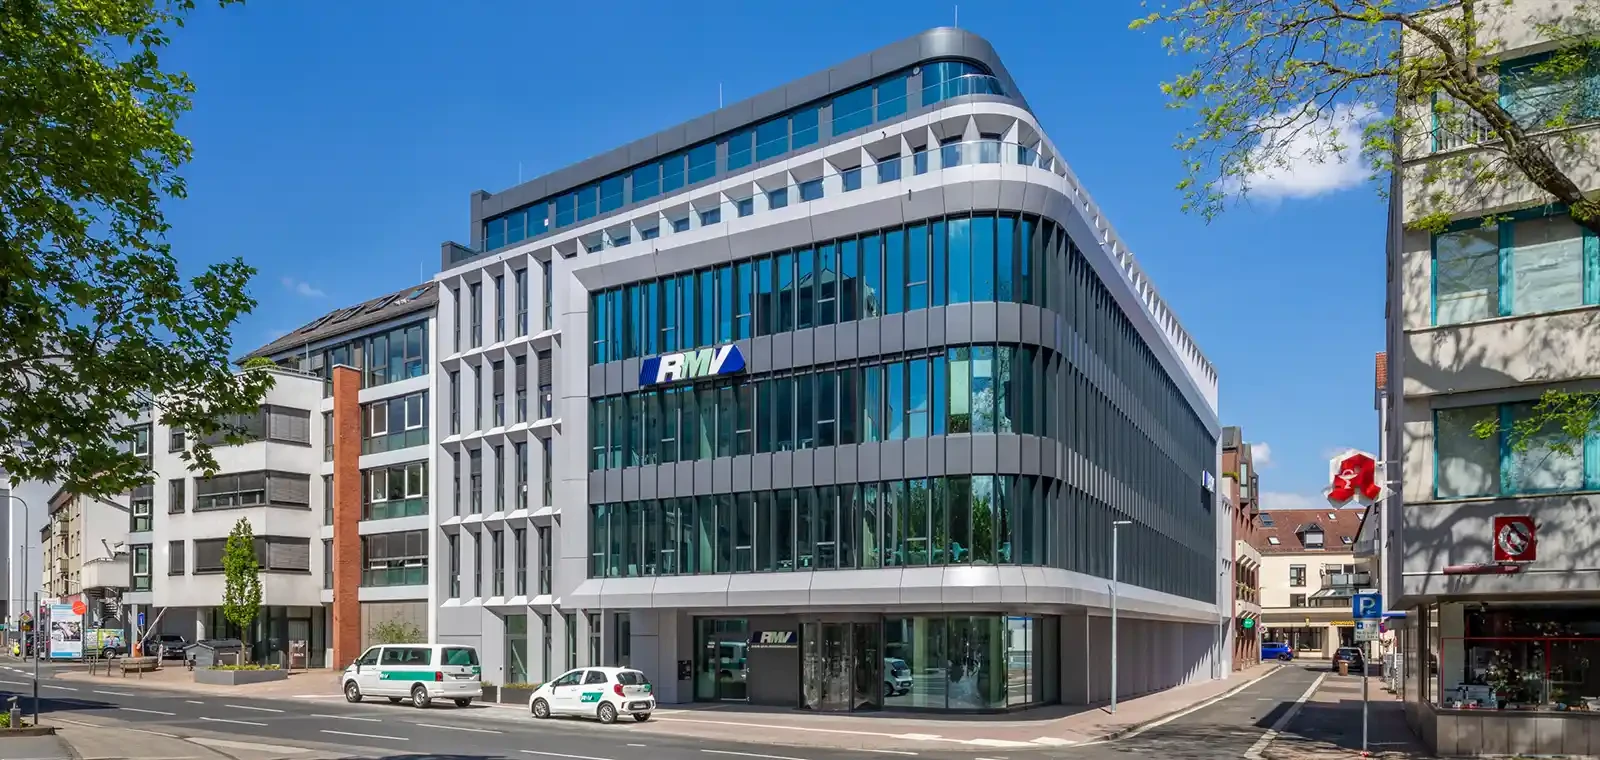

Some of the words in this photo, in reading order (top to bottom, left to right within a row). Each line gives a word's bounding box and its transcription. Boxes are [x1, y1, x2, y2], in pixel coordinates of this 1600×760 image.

[656, 344, 735, 383] RMV
[1360, 597, 1376, 616] P
[760, 631, 793, 643] RMV
